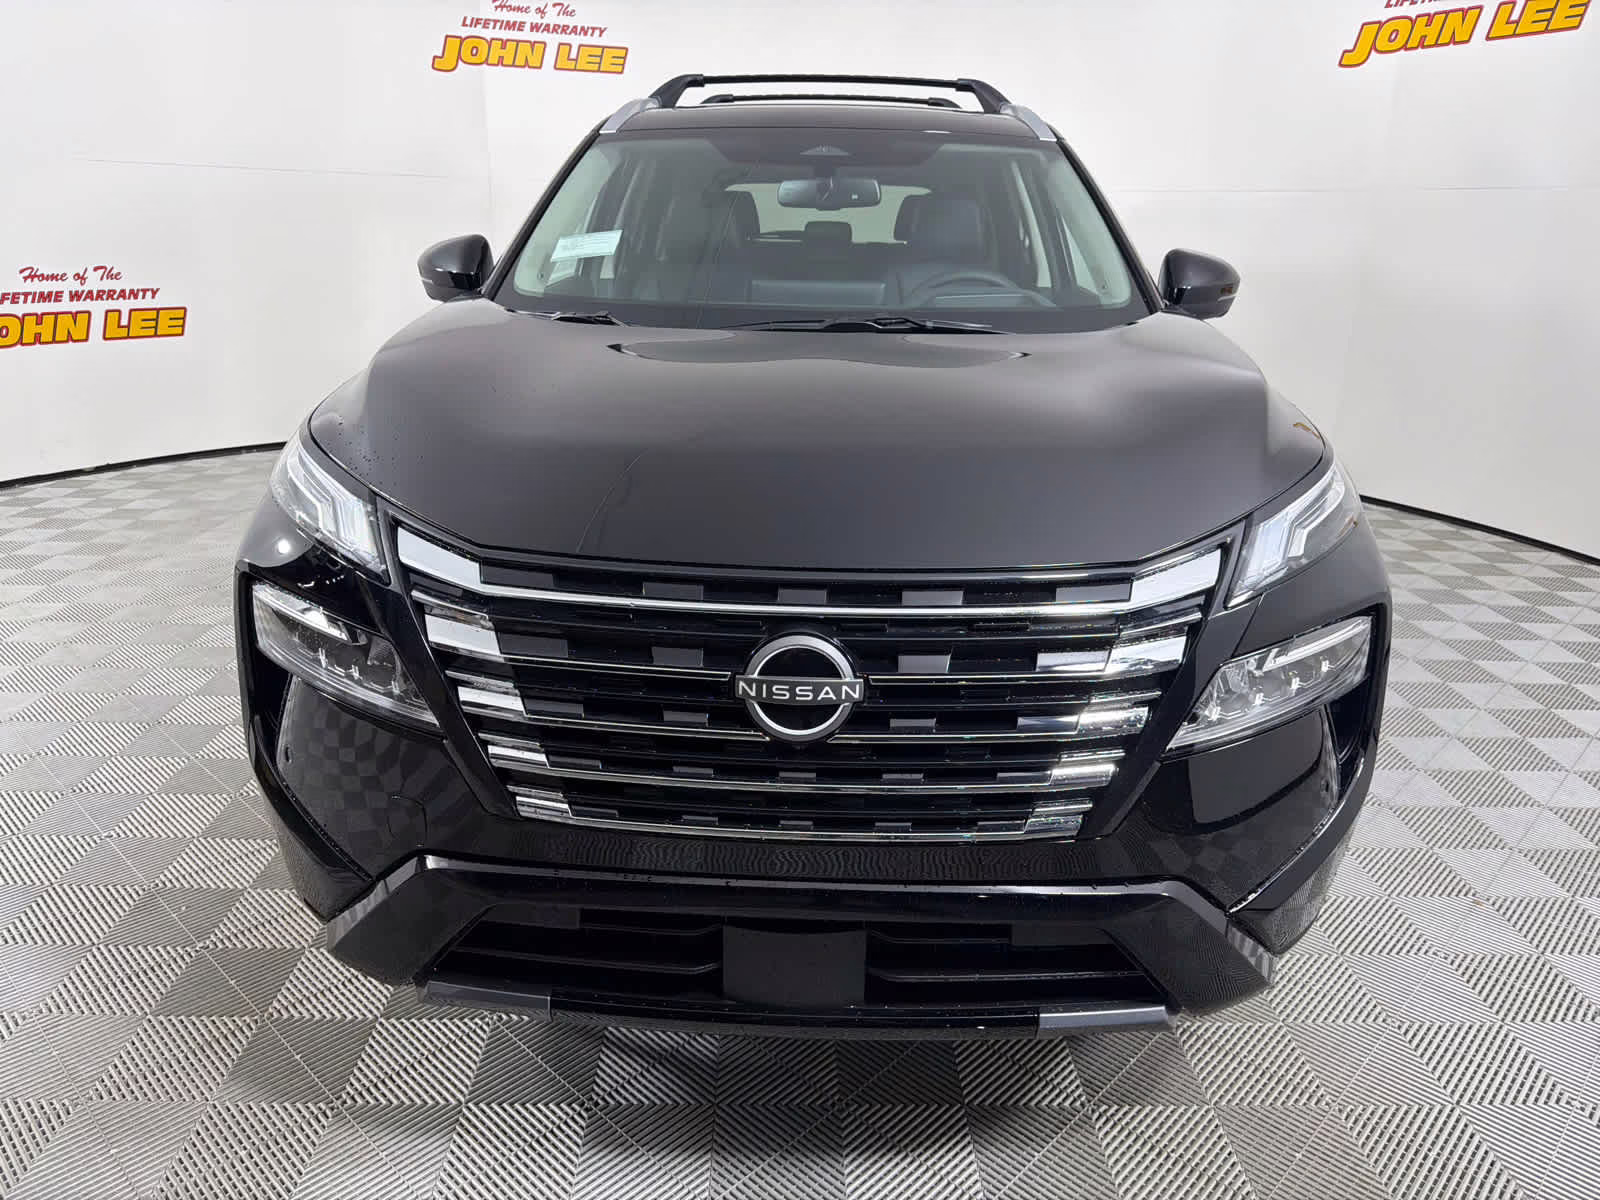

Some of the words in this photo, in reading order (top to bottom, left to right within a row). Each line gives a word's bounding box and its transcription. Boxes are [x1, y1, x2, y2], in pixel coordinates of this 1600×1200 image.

[491, 0, 530, 14] Home
[535, 3, 548, 18] of
[552, 2, 576, 17] The
[461, 16, 526, 32] LIFETIME
[529, 21, 607, 37] WARRANTY
[1338, 5, 1484, 68] JOHN
[1485, 0, 1590, 41] LEE
[432, 35, 546, 72] JOHN
[554, 42, 628, 74] LEE
[19, 266, 68, 283] Home
[72, 267, 88, 285] of
[93, 265, 122, 281] The
[69, 287, 160, 302] WARRANTY
[102, 306, 187, 340] LEE
[738, 681, 859, 700] NISSAN
